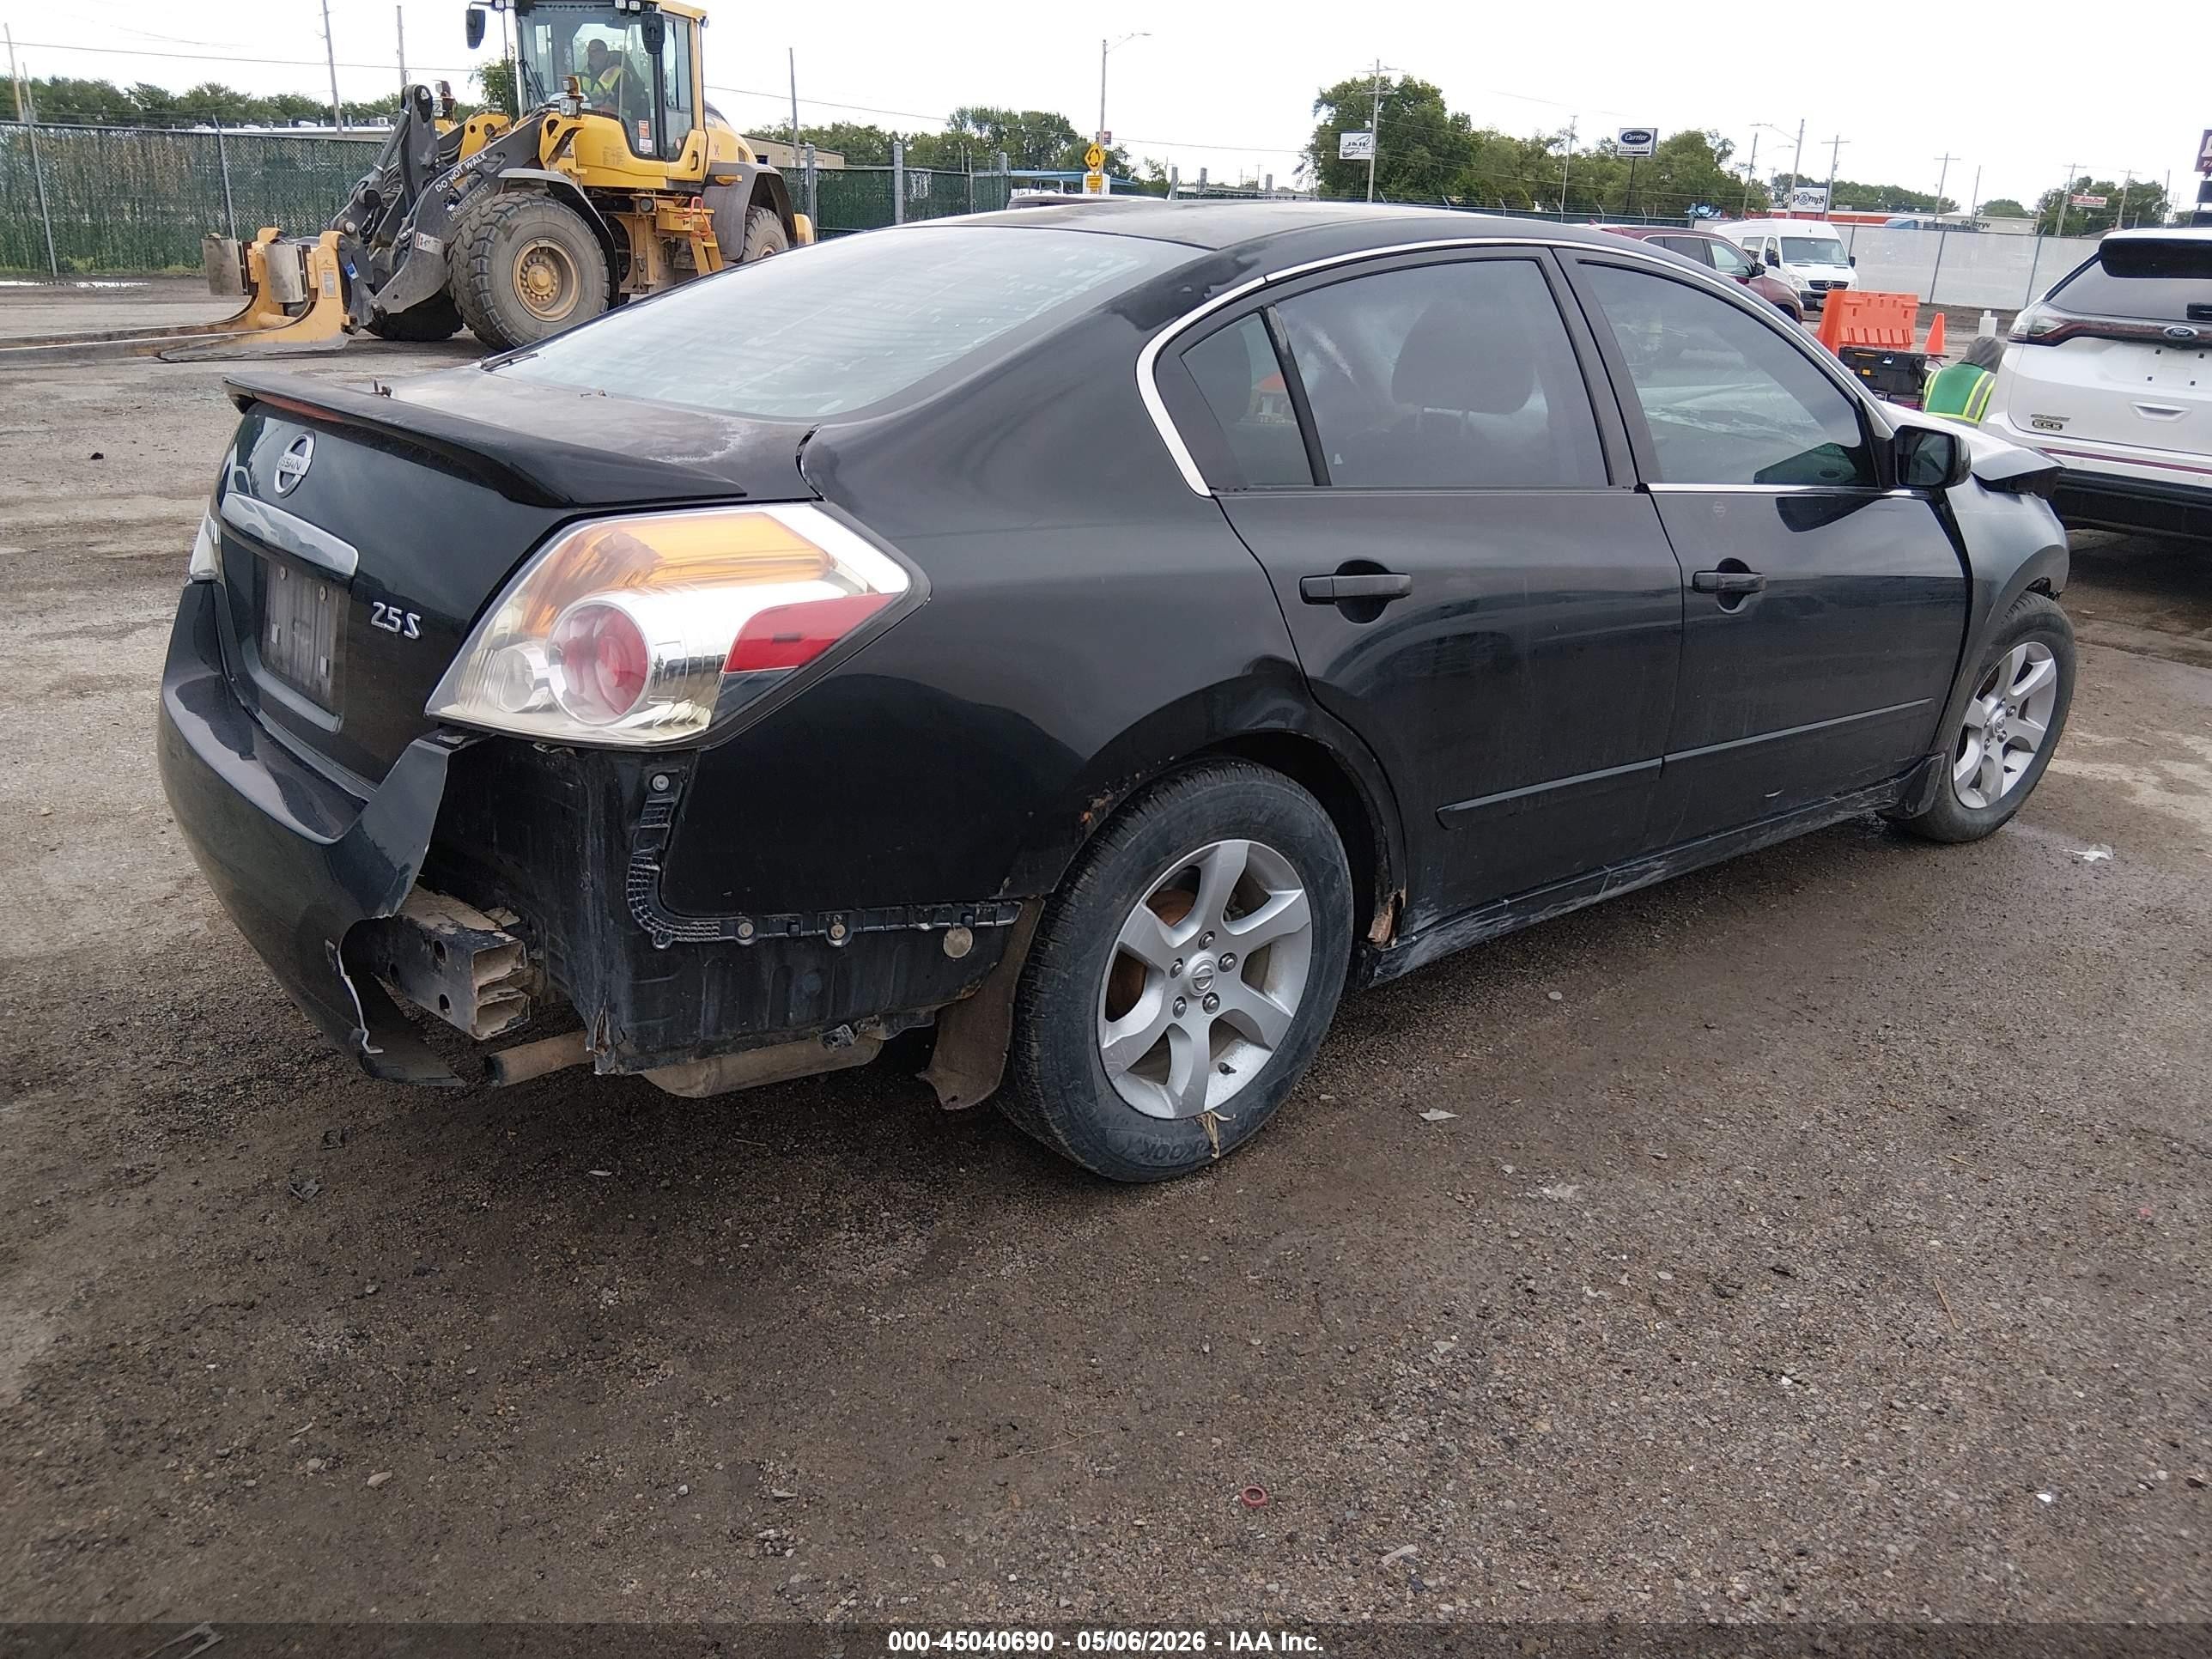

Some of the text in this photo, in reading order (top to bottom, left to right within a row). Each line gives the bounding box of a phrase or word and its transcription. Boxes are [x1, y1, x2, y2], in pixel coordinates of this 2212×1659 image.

[545, 3, 595, 12] VOLVO
[434, 152, 488, 193] DO NOT WALK
[448, 183, 490, 222] UNDER MAST
